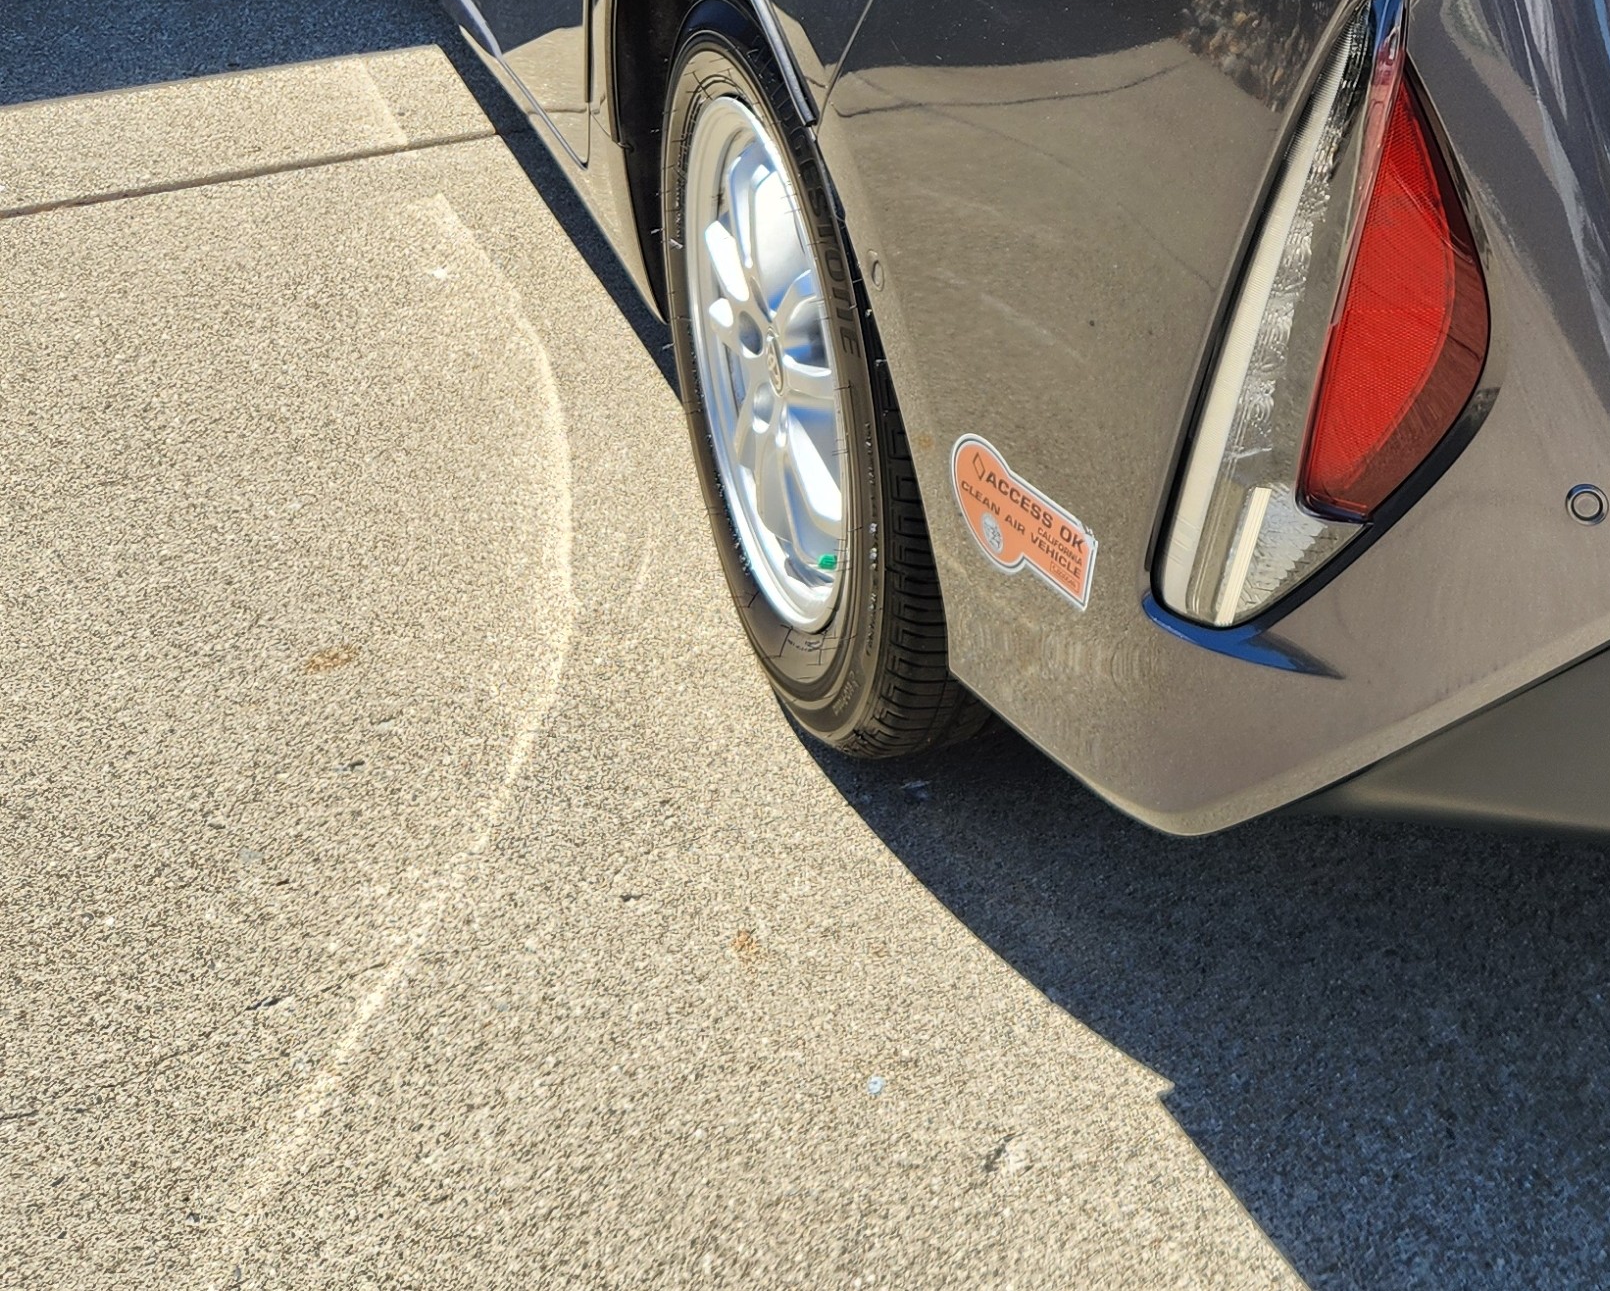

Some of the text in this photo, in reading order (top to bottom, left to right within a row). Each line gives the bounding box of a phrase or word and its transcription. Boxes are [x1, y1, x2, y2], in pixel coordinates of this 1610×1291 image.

[961, 480, 1001, 515] CLEAN
[1004, 514, 1026, 536] AIR
[1030, 532, 1081, 580] VEHICLE
[985, 471, 1085, 553] ACCESS OK
[1037, 527, 1082, 565] CALIFORNIA
